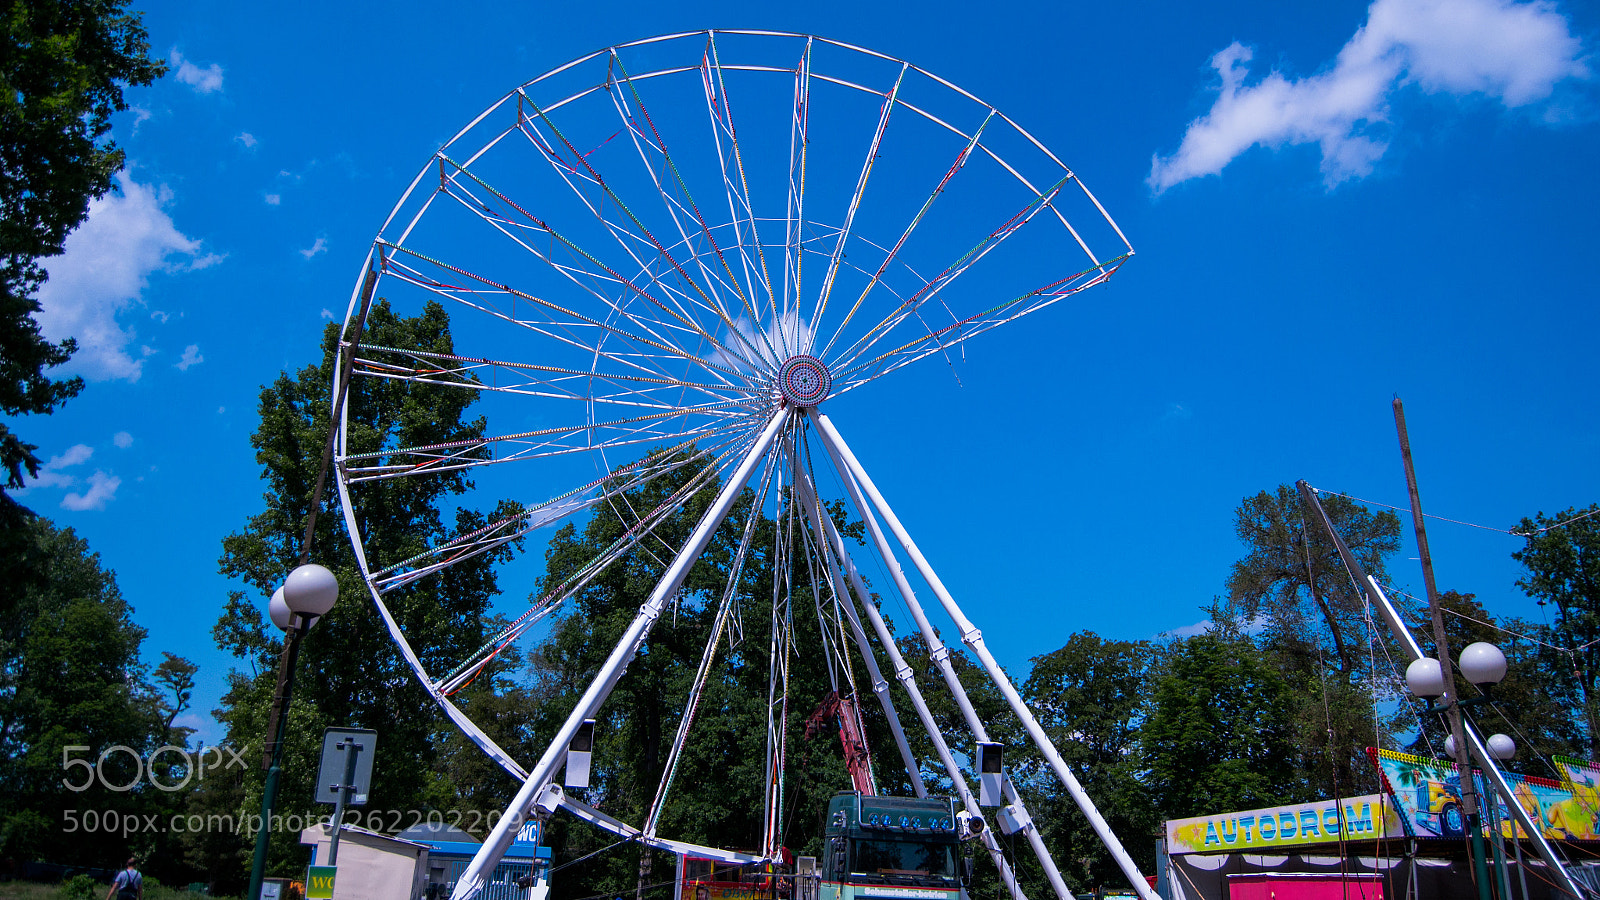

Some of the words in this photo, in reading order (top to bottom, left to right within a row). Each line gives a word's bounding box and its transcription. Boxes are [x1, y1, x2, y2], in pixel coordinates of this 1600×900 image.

[517, 824, 537, 842] WC
[1205, 803, 1374, 847] AUTODROM
[312, 876, 335, 889] WC
